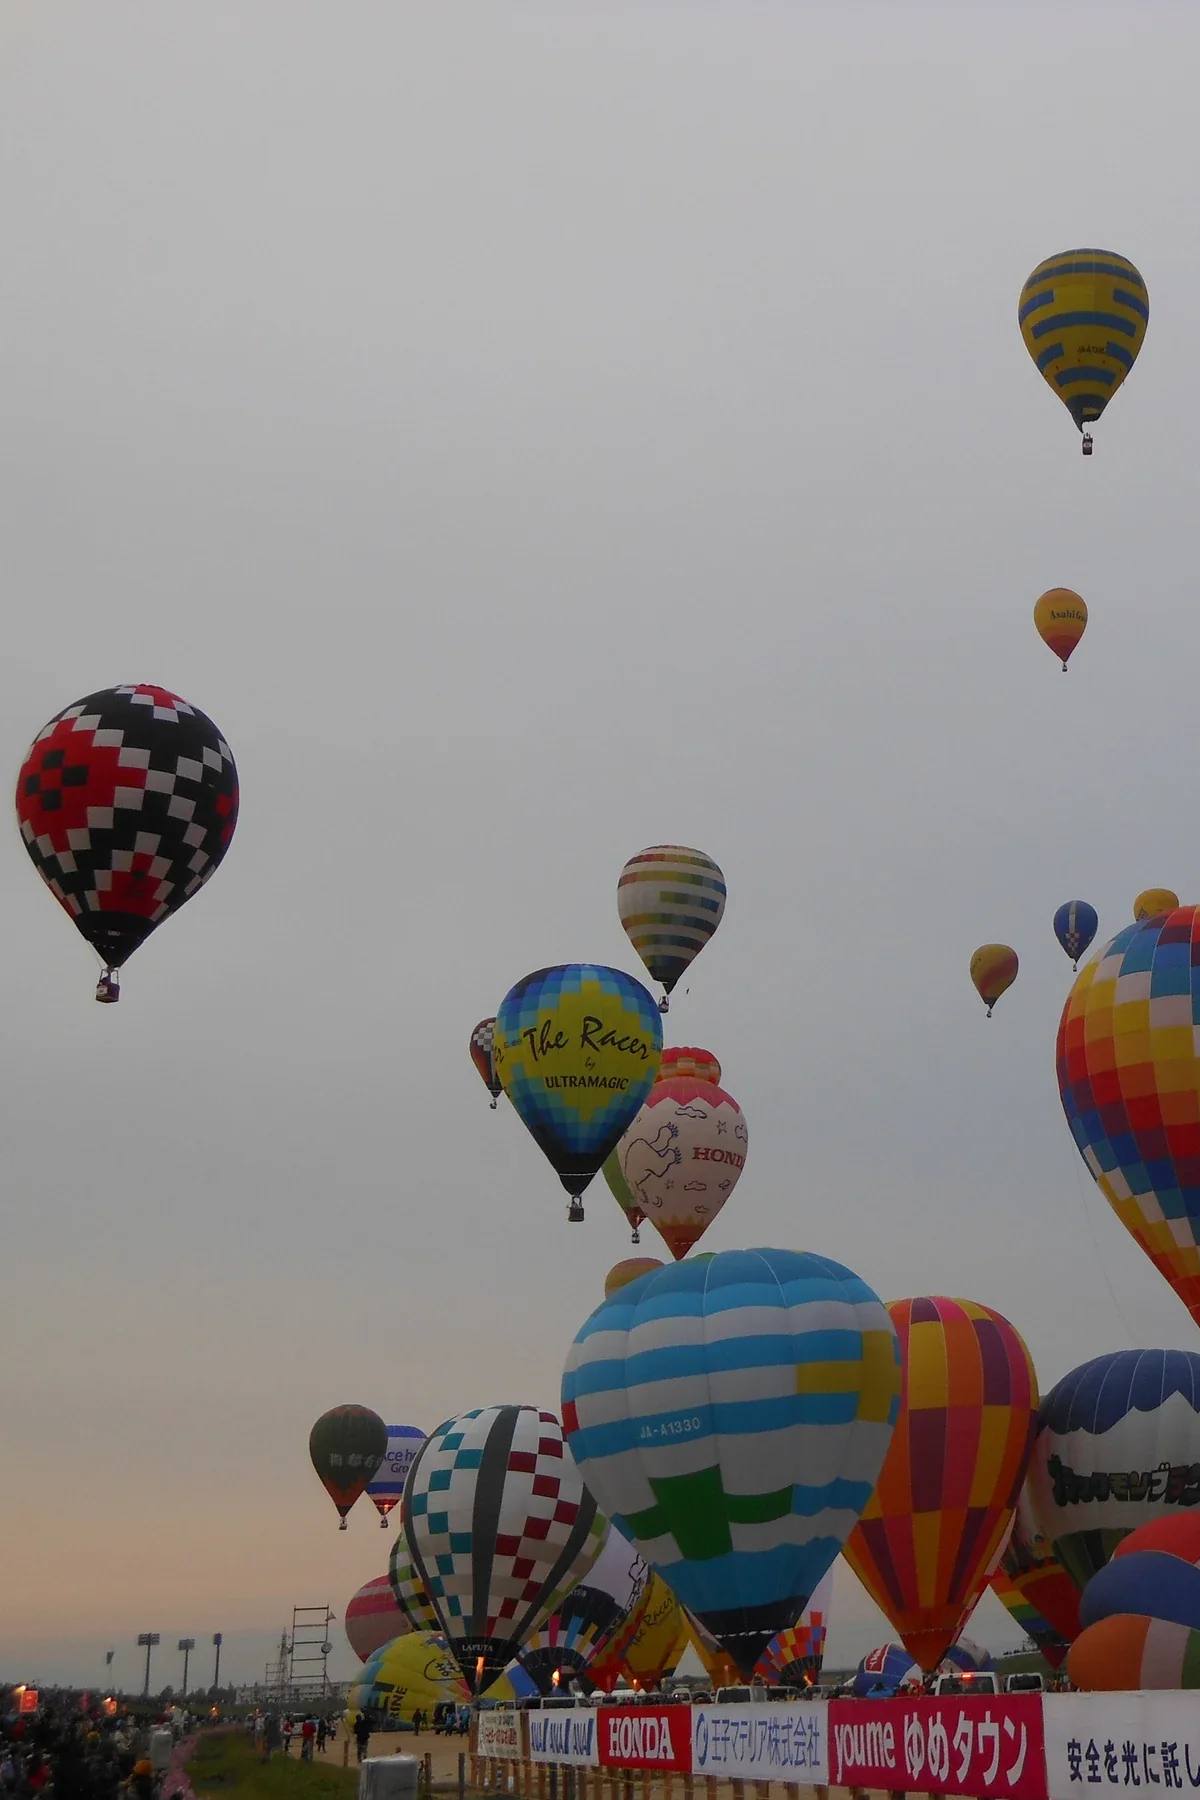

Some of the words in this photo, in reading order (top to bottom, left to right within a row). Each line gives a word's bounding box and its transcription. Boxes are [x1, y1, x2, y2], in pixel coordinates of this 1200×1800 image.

[523, 1019, 569, 1062] The
[580, 1016, 651, 1060] Racer
[585, 1057, 596, 1071] by
[545, 1076, 630, 1091] ULTRAMAGIC
[640, 1417, 701, 1439] JA-A1330
[461, 1644, 493, 1652] LAPUTA
[608, 1716, 675, 1759] HONDA
[711, 1715, 820, 1768] 王子マテリア株式会社
[834, 1720, 896, 1783] youme
[903, 1710, 1028, 1787] ゆめタウン
